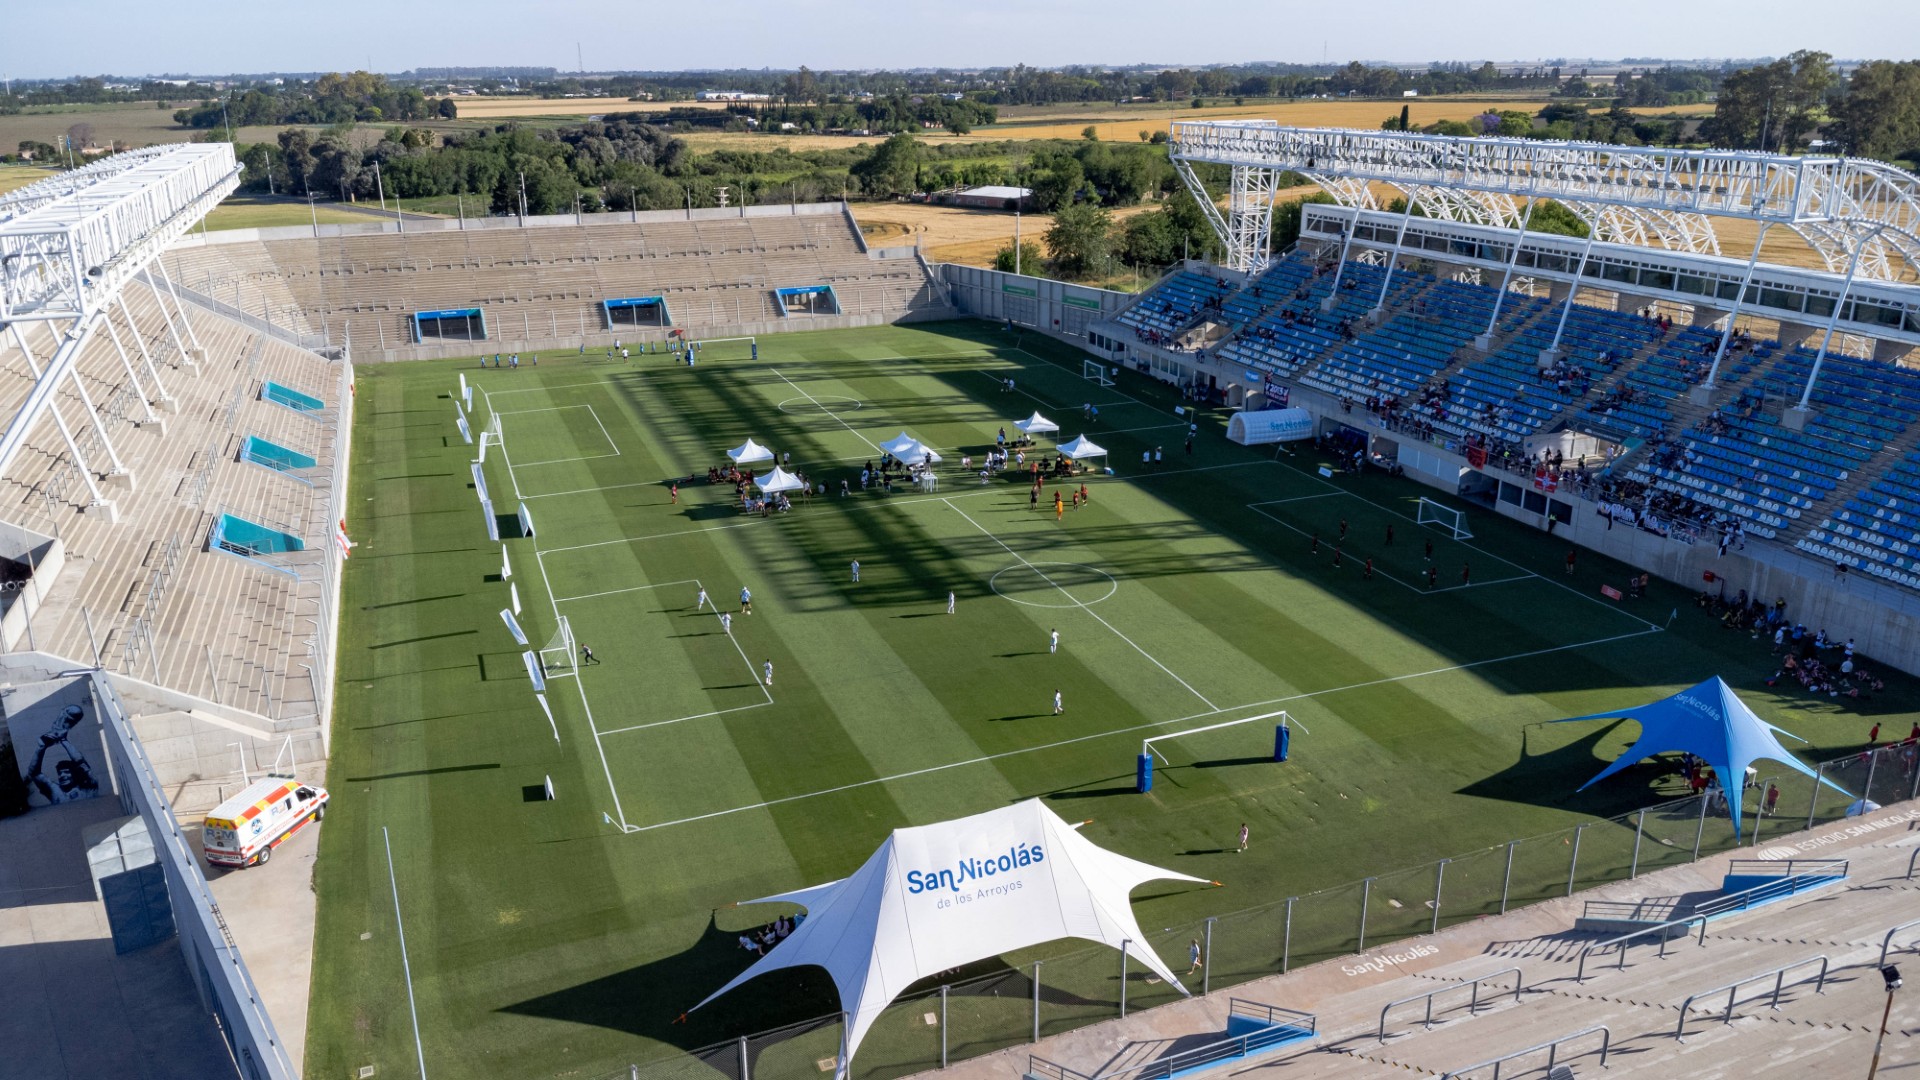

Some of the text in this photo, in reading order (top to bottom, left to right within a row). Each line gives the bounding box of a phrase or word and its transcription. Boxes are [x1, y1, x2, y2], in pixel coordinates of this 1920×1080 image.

[1799, 831, 1849, 851] ESTADIO
[1845, 824, 1876, 837] SAN
[907, 842, 1044, 894] San Nicolás
[937, 879, 1023, 909] de los Arroyos
[1341, 944, 1440, 977] San Nicolás
